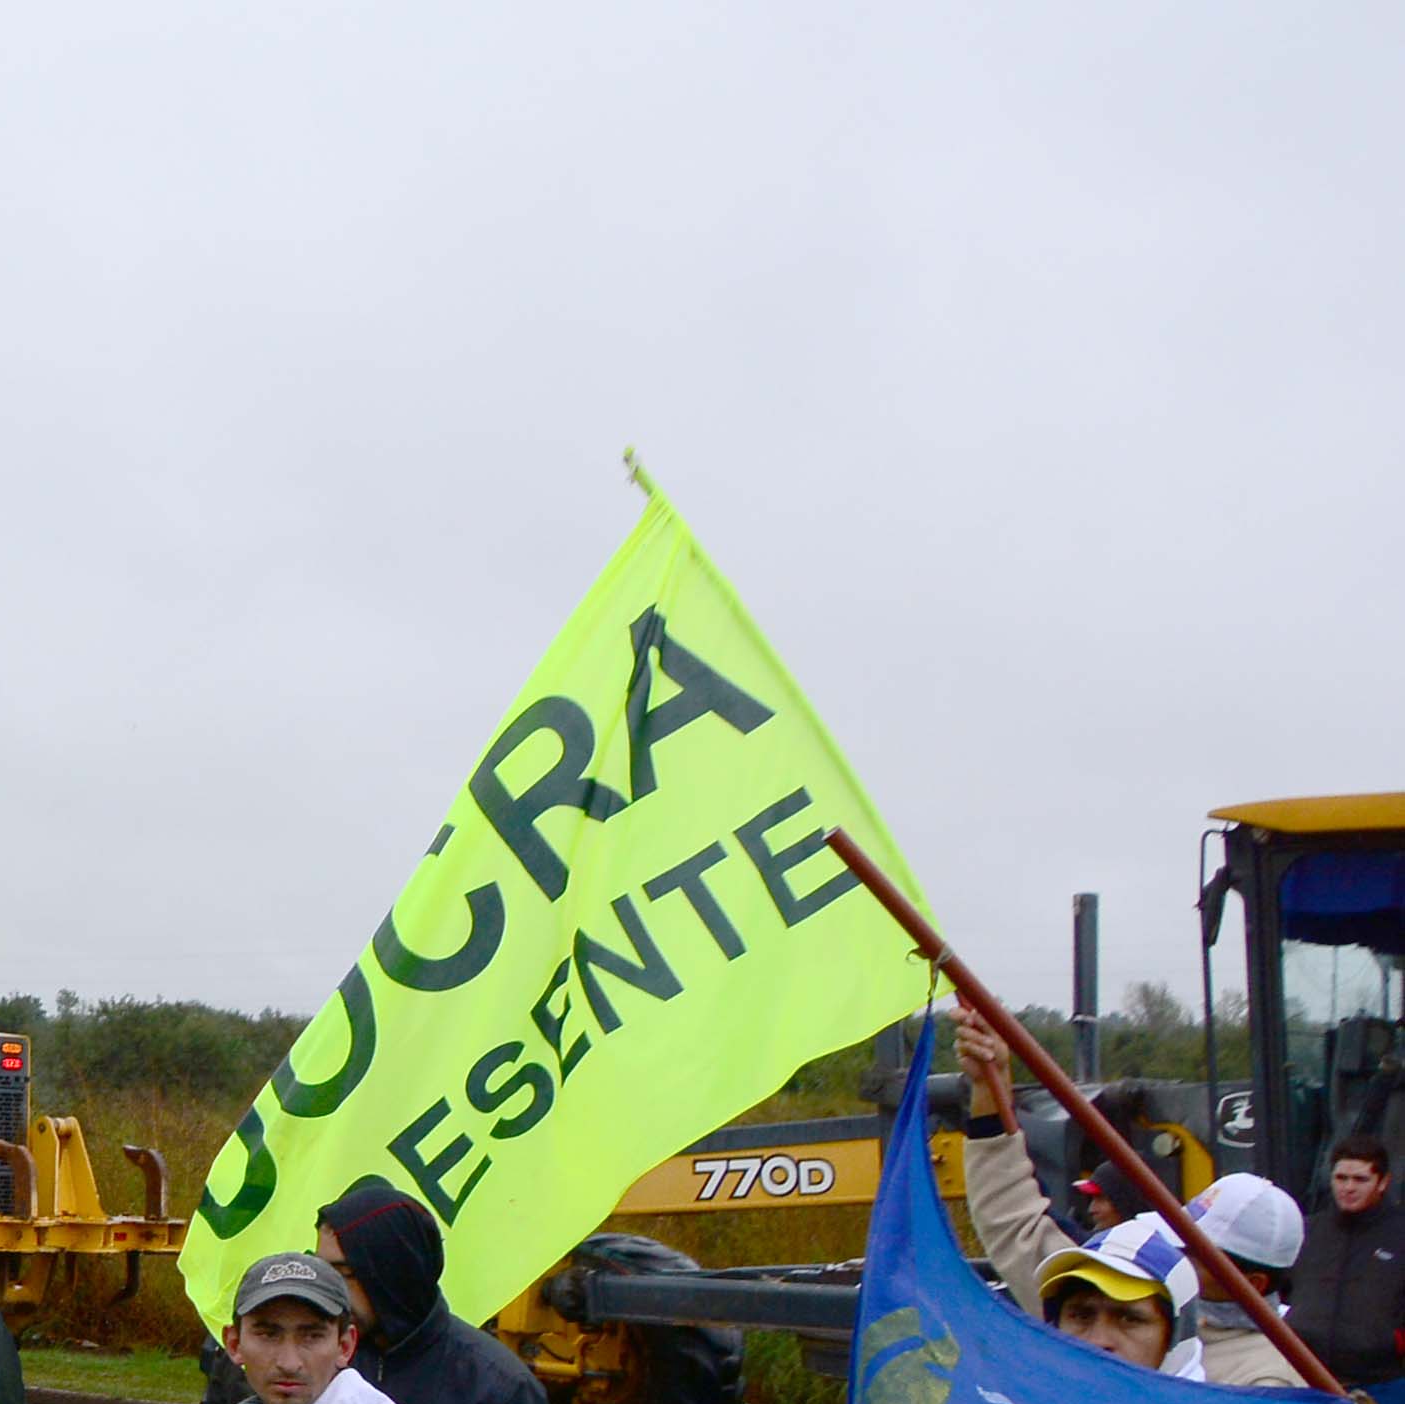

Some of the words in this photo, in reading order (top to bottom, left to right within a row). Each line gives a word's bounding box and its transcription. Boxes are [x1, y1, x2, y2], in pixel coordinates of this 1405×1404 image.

[194, 603, 775, 1239] UOCRA
[387, 786, 865, 1228] ESENTE
[693, 1155, 836, 1200] 770D
